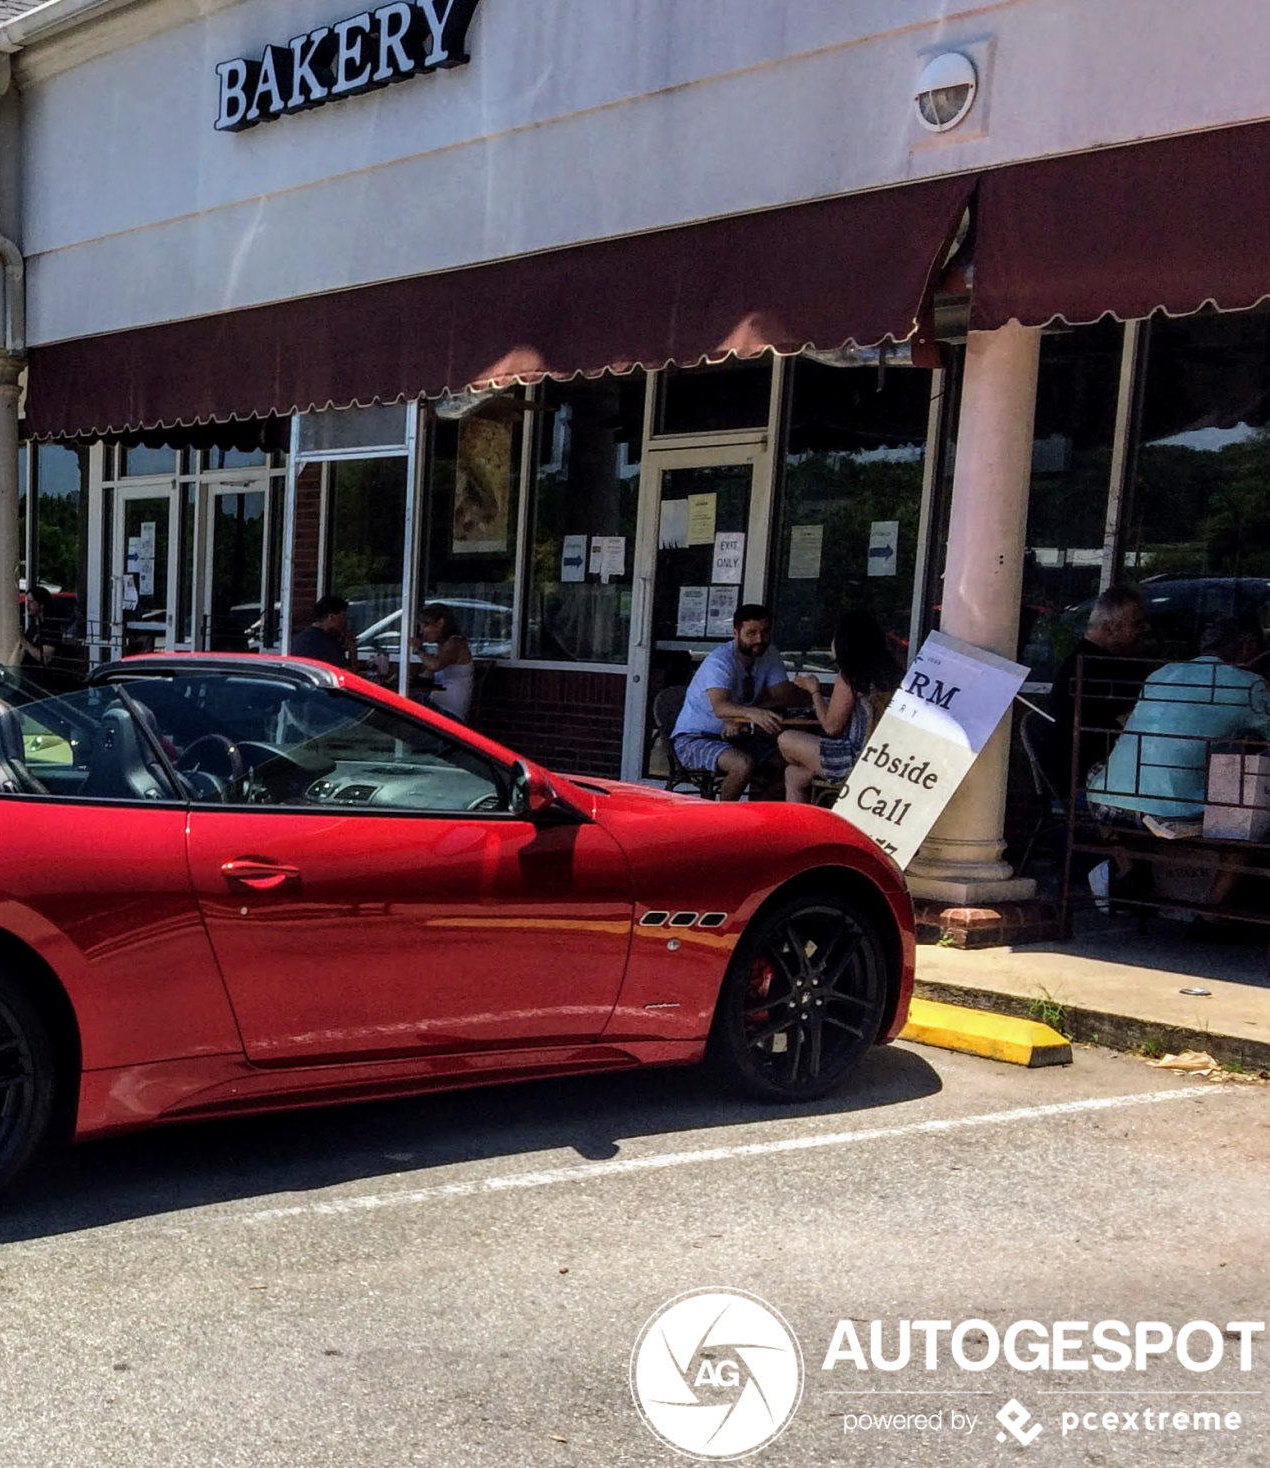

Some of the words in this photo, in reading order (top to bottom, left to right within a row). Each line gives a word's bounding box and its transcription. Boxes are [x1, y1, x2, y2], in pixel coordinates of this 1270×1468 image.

[214, 0, 454, 131] BAKERY
[716, 558, 739, 568] ONLY
[720, 540, 738, 551] EXIT
[900, 671, 961, 711] RM
[857, 785, 912, 826] Call
